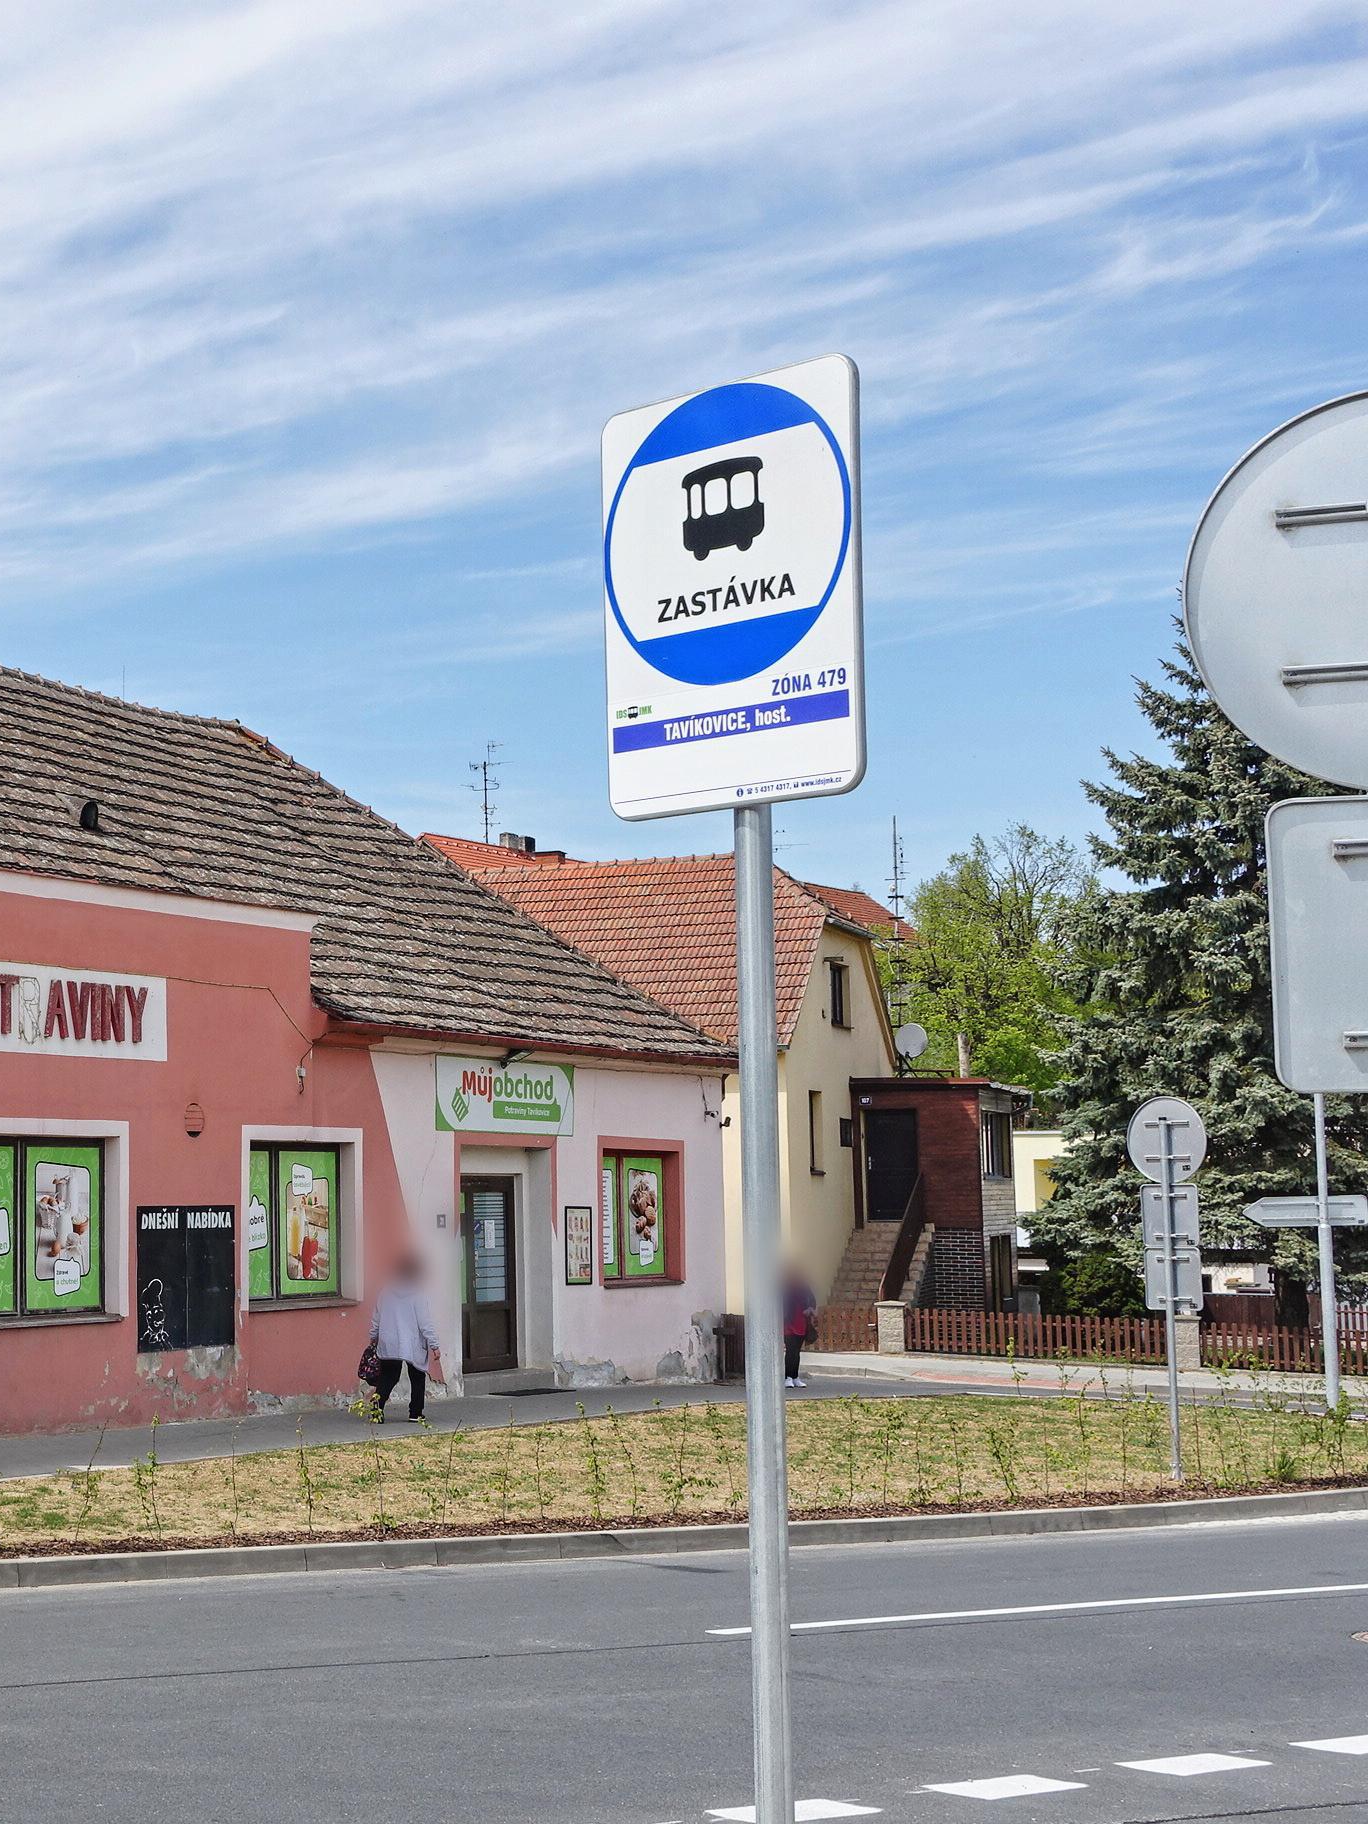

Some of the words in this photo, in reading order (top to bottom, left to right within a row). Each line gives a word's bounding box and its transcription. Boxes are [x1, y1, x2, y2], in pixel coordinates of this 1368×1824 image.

[657, 573, 796, 623] ZASTÁVKA
[771, 673, 812, 696] ZÓNA
[817, 667, 847, 688] 479
[664, 711, 751, 741] TAVÍKOVICE,
[755, 705, 791, 727] host.
[141, 1208, 179, 1229] DNEŠNÍ
[187, 1208, 232, 1229] NABÍDKA
[249, 1214, 265, 1225] obré
